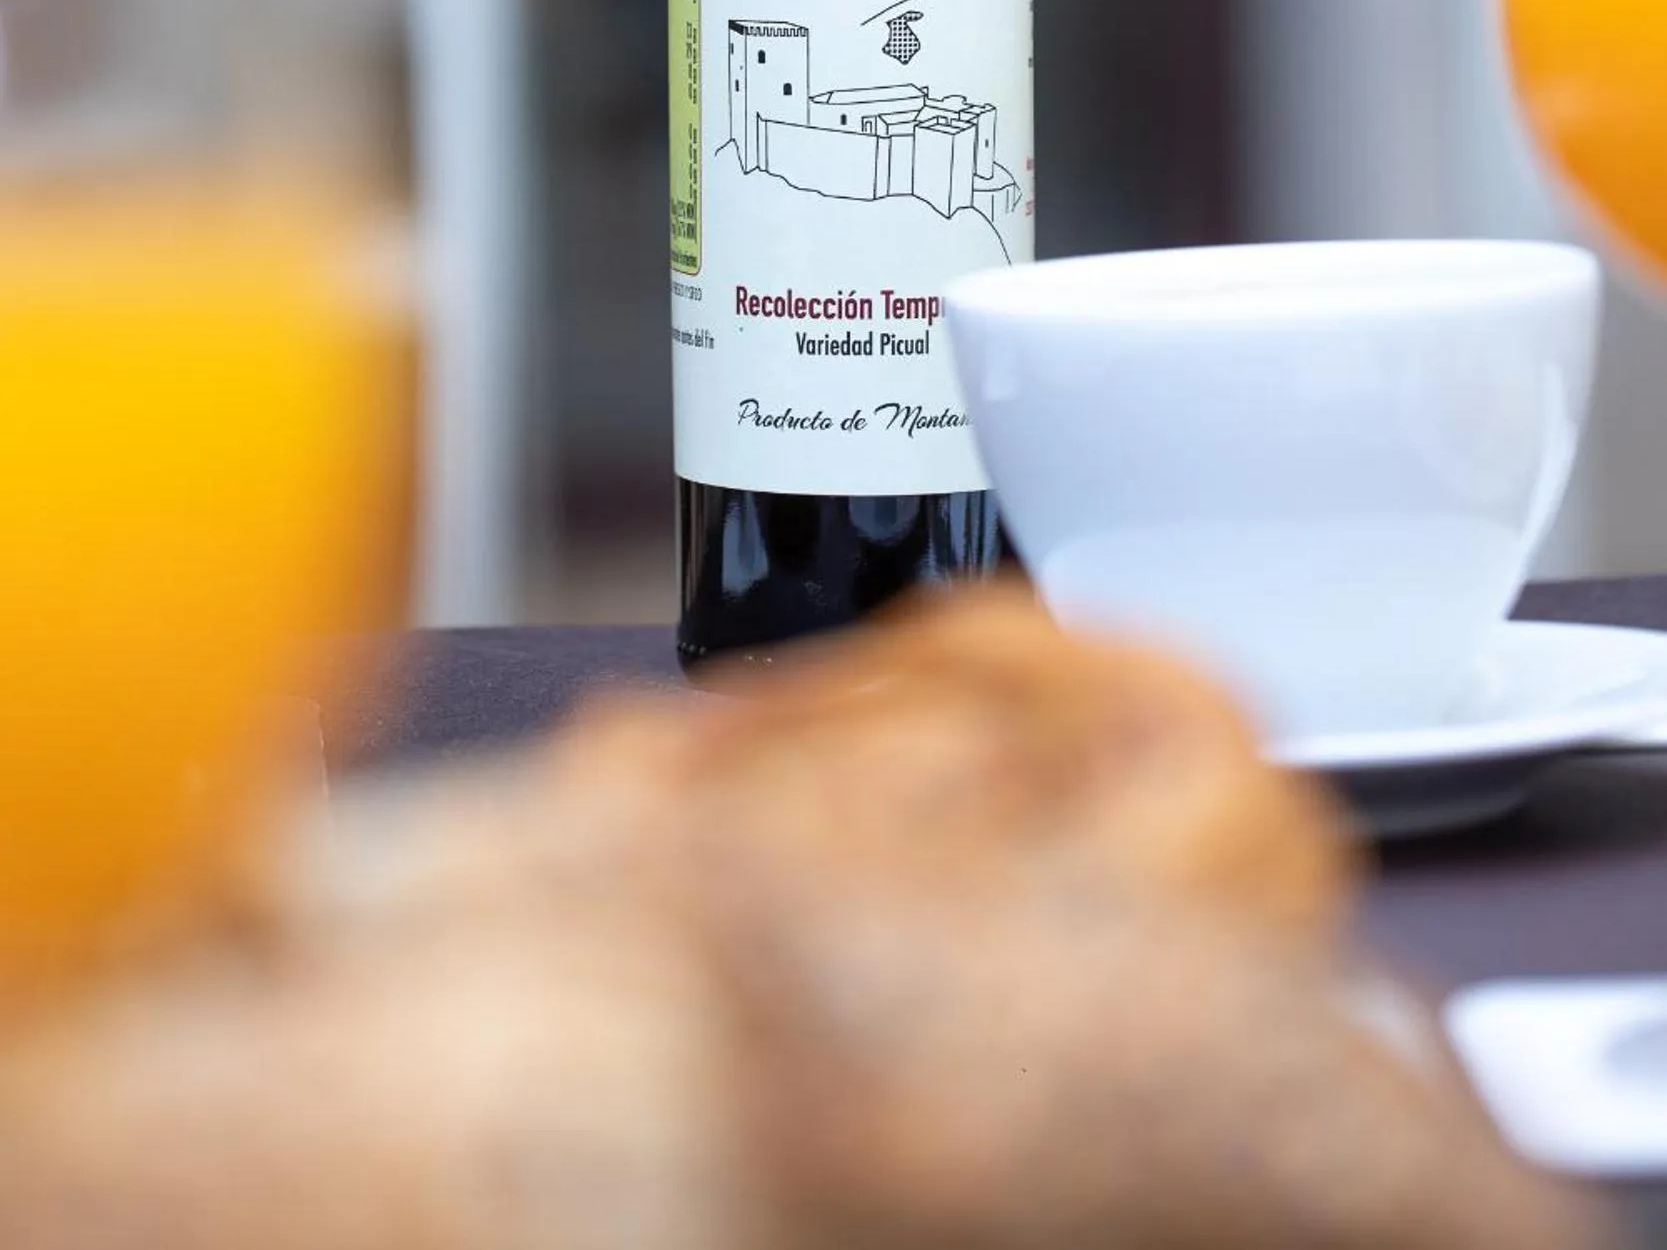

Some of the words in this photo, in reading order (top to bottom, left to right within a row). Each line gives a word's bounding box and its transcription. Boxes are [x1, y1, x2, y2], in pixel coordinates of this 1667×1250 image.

[735, 286, 873, 321] Recolección
[796, 332, 873, 356] Variedad
[880, 330, 930, 356] Picual
[737, 397, 834, 433] Producto
[840, 409, 867, 432] de
